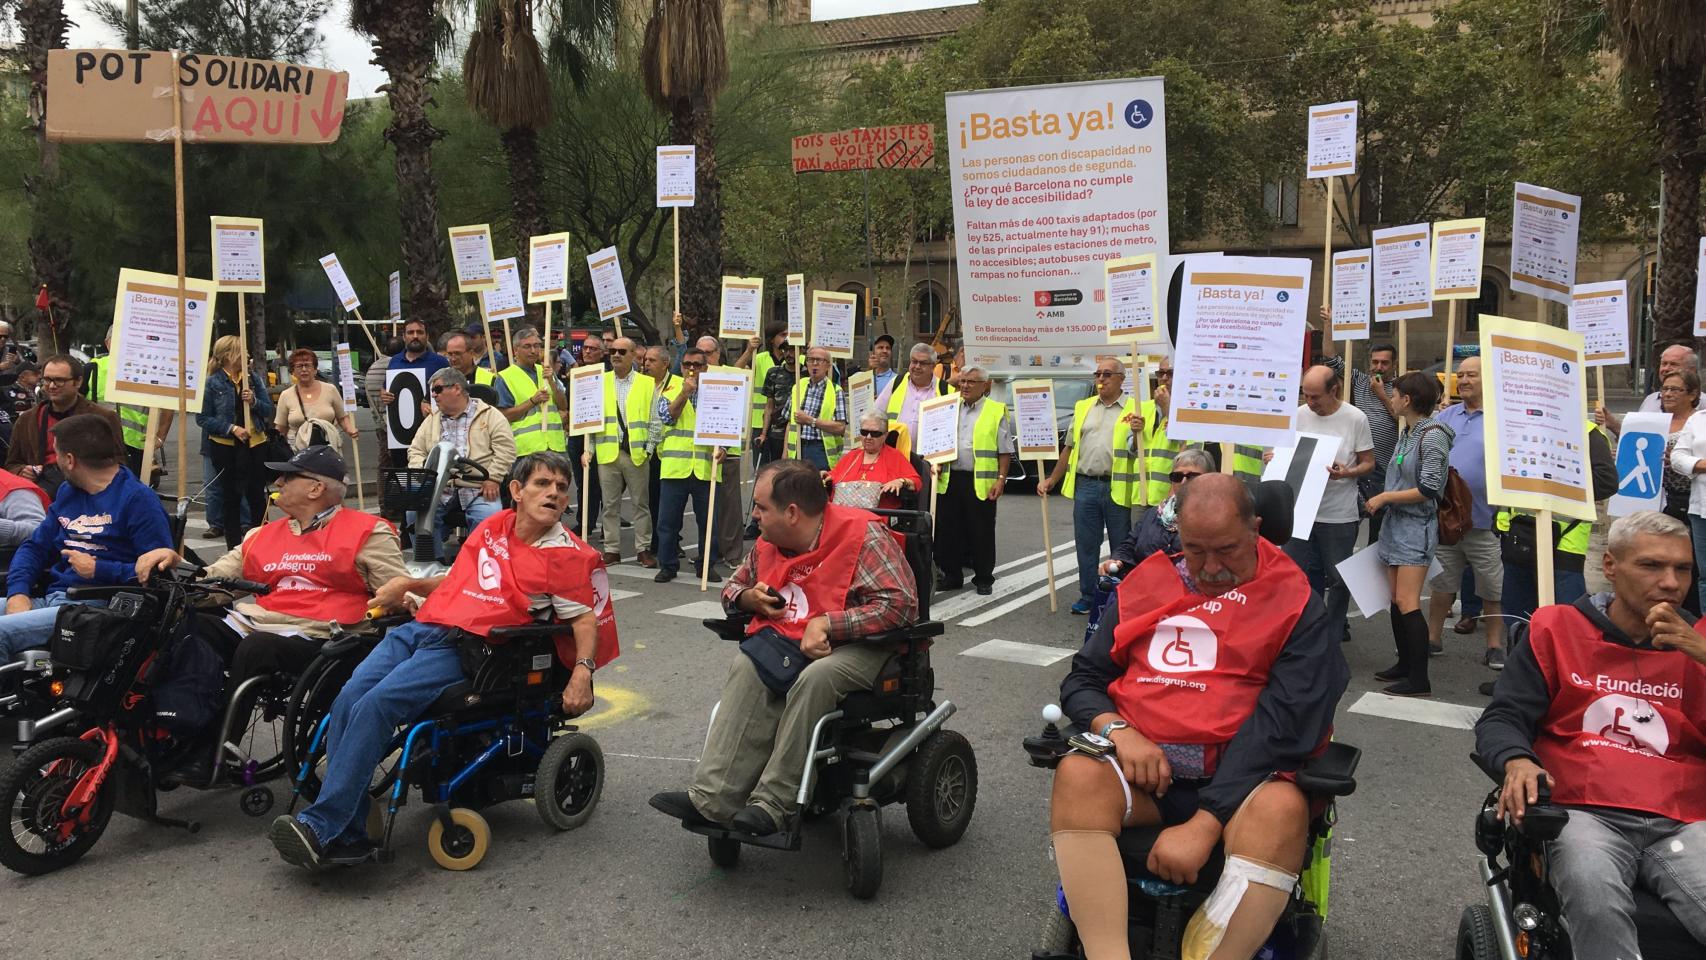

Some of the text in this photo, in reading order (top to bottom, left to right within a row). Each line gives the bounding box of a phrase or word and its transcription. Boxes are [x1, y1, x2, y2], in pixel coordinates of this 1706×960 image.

[76, 52, 313, 96] POT SOLIDARI
[960, 102, 1114, 149] ¡Basta ya!
[851, 125, 928, 143] TAXISTES
[834, 142, 887, 157] VOLEM
[962, 144, 1152, 170] Las personas con discapacidad no
[962, 159, 1136, 181] somos ciudadanos de segunda.
[964, 174, 1133, 198] ¿Por qué Barcelona no cumple
[965, 189, 1093, 209] la ley de accesibilidad?
[967, 209, 1157, 230] Faltan más de 400 taxis adaptados (por
[968, 223, 1150, 244] ley 525, actualmente hay 91); muchas
[968, 236, 1157, 256] de las principales estaciones de metro,
[982, 258, 1037, 267] accesibles;
[1038, 254, 1090, 265] autobuses
[1092, 252, 1121, 262] cuyas
[970, 271, 1005, 281] rampas
[1007, 271, 1019, 279] no
[972, 294, 1021, 304] Culpables:
[1198, 287, 1265, 302] ¡Basta ya!
[165, 299, 176, 308] ya
[1195, 317, 1209, 325] ¿Por
[1023, 326, 1036, 334] hay
[1037, 325, 1053, 333] más
[989, 335, 1040, 343] discapacidad.
[1500, 351, 1555, 370] ¡Basta ya!
[281, 552, 332, 563] Fundación
[277, 561, 316, 573] Disgrup
